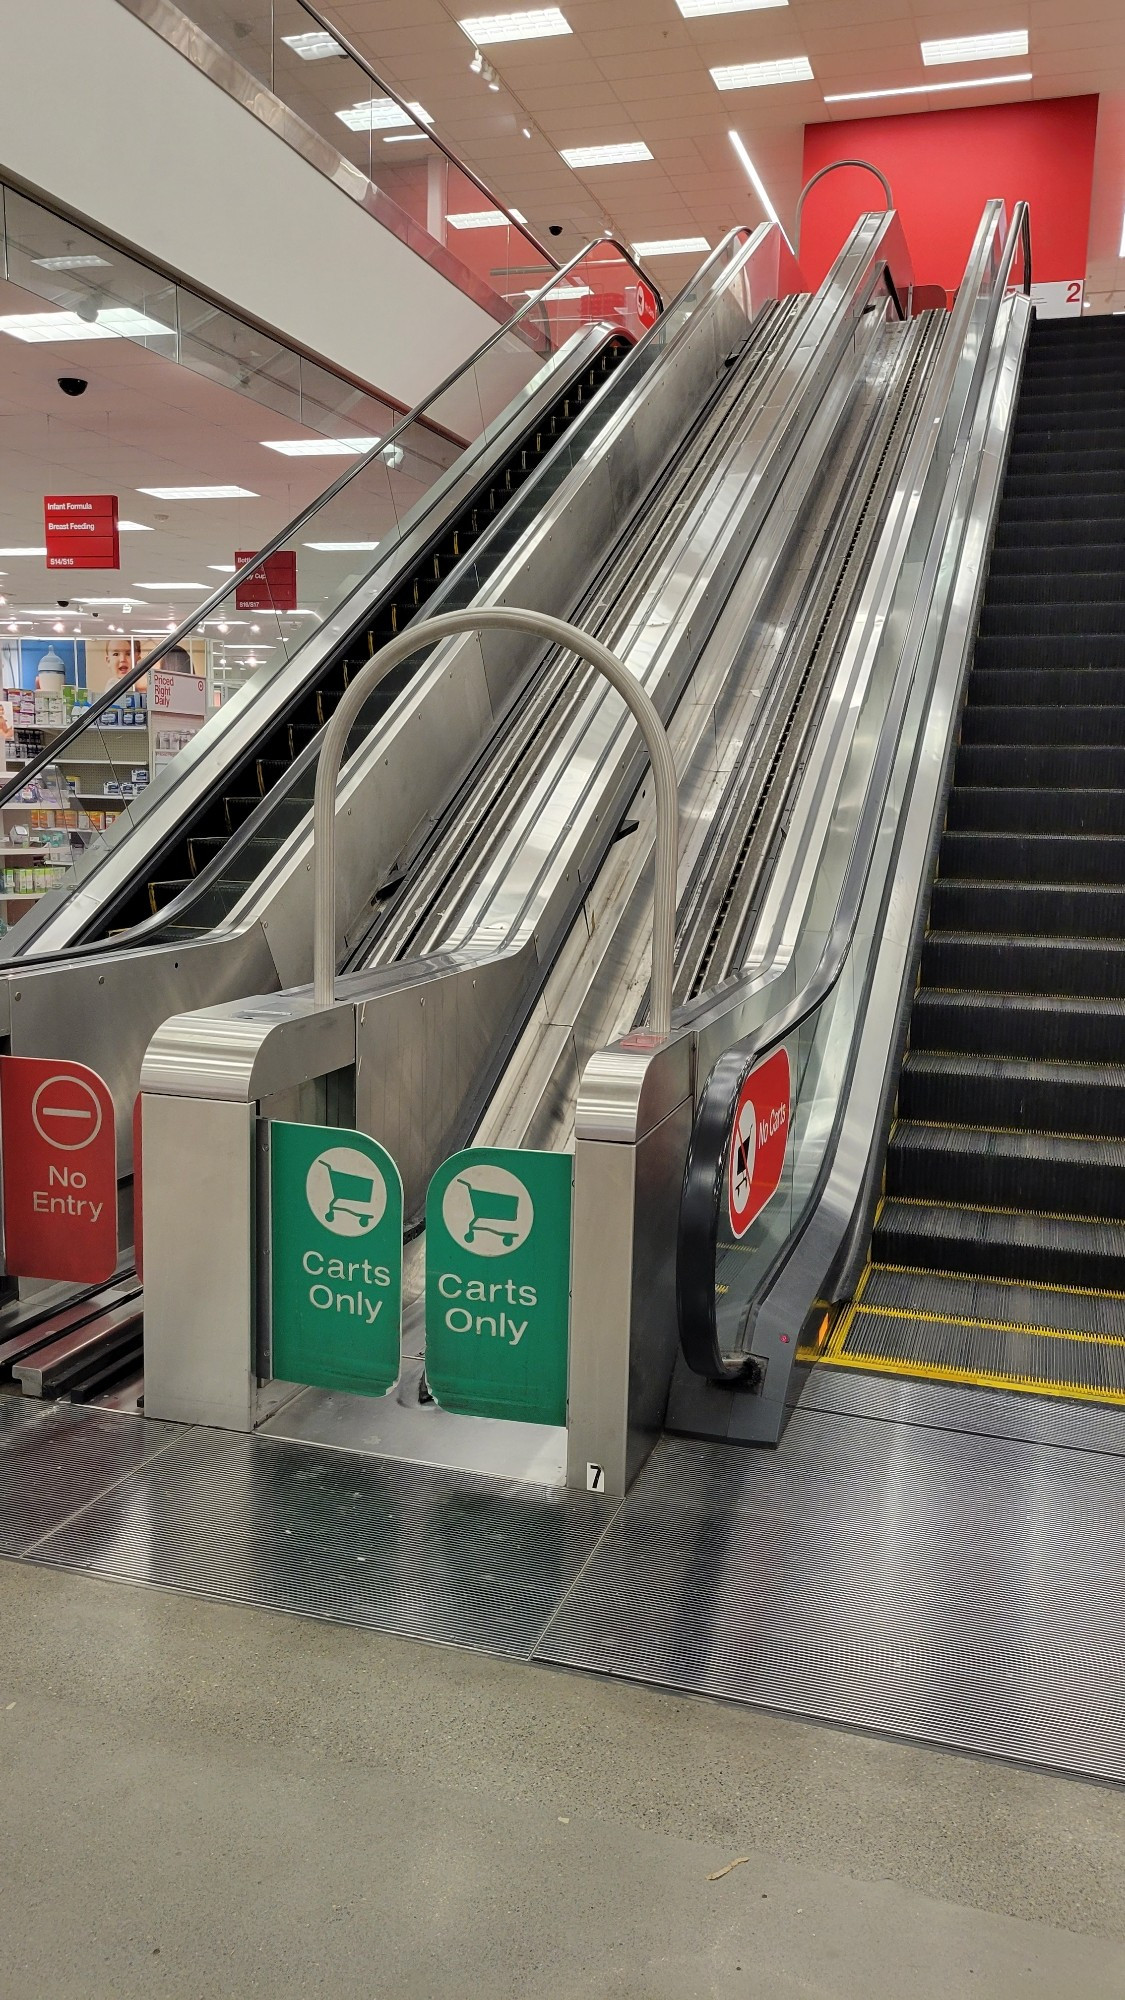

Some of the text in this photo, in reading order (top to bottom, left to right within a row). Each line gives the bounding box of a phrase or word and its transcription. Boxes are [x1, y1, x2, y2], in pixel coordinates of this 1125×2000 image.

[1066, 282, 1081, 303] 2
[66, 502, 93, 510] Formula
[48, 522, 95, 531] Breast Feeding
[154, 674, 174, 687] Priced
[154, 684, 171, 697] Right
[154, 695, 170, 707] Daily
[758, 1102, 786, 1149] No Carts
[49, 1165, 87, 1189] No
[33, 1191, 103, 1223] Entry
[302, 1250, 391, 1287] Carts
[438, 1273, 538, 1306] Carts
[309, 1284, 383, 1324] Only
[445, 1307, 529, 1346] Only
[590, 1465, 602, 1489] 7
